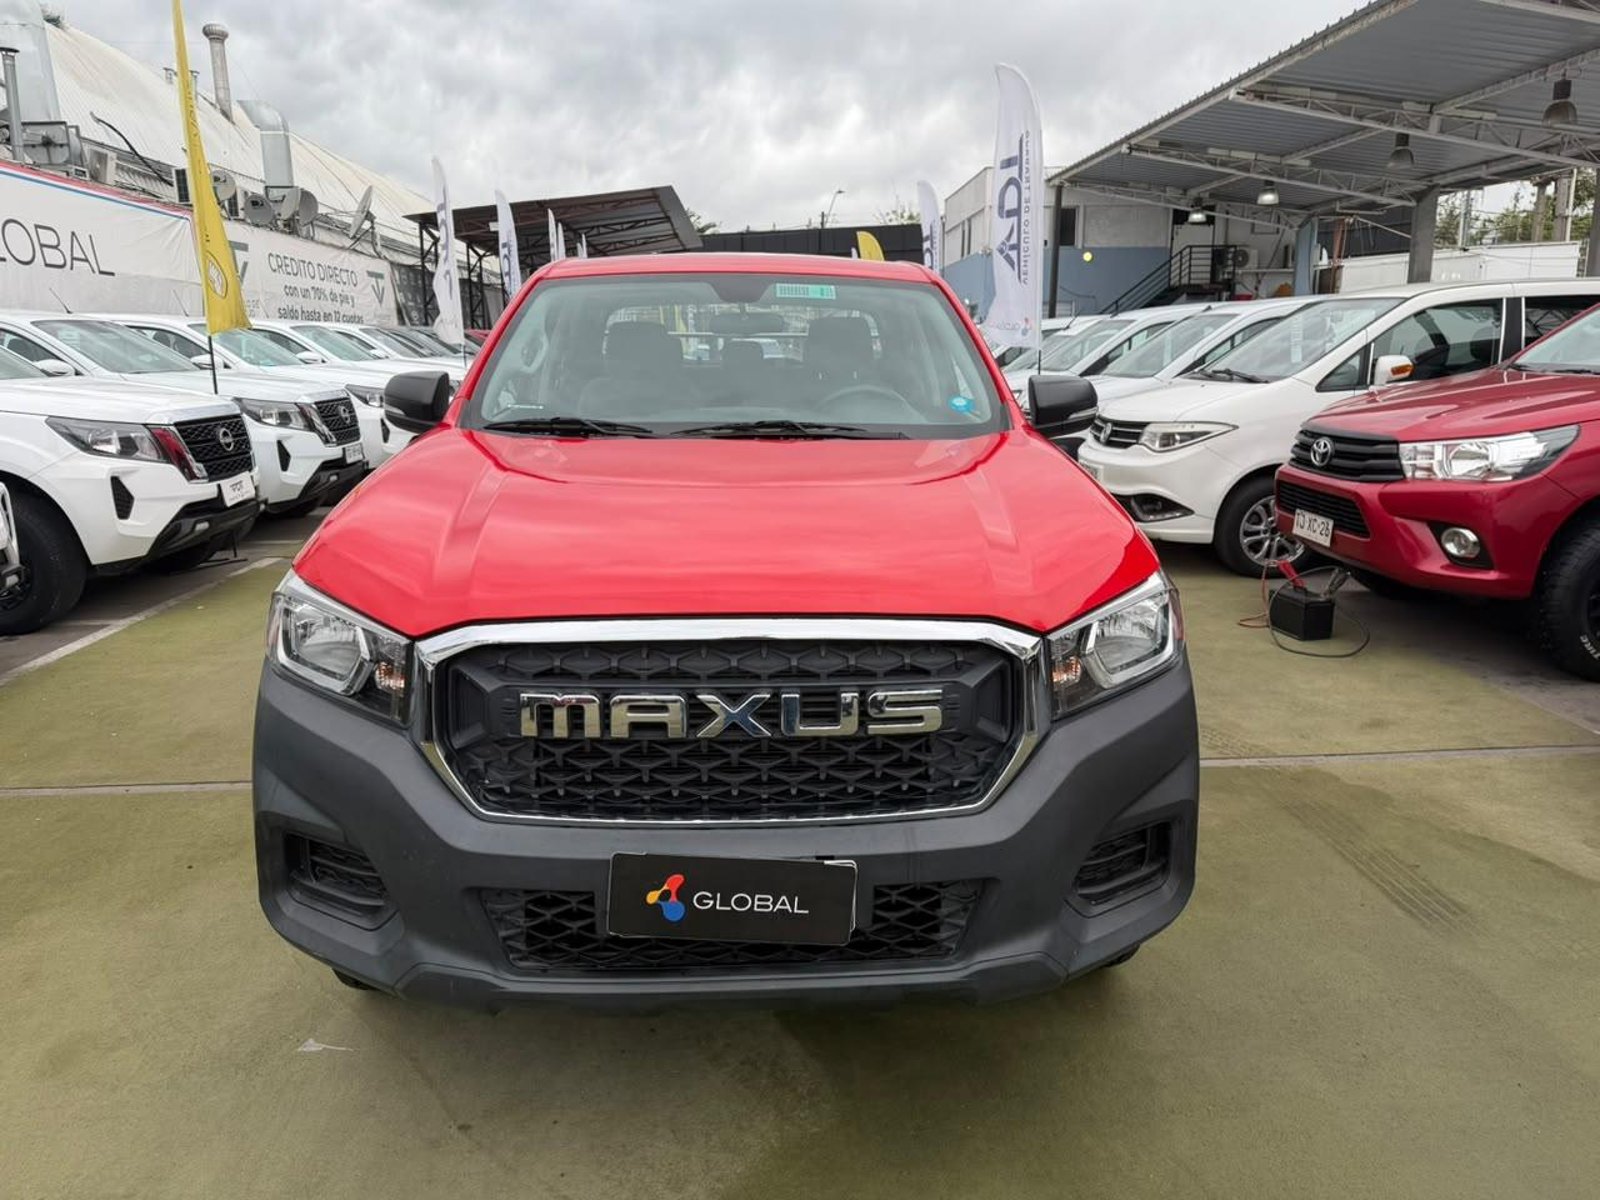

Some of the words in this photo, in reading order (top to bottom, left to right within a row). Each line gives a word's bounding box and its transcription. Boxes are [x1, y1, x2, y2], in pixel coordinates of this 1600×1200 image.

[0, 218, 115, 276] OBAL
[284, 284, 299, 299] con
[300, 287, 311, 300] un
[329, 289, 338, 303] de
[277, 304, 299, 320] saldo
[300, 306, 322, 322] hasta
[323, 311, 333, 322] en
[333, 310, 341, 322] 12
[342, 312, 364, 324] cuotas
[519, 689, 944, 738] MAXUS
[693, 891, 809, 916] GLOBAL
